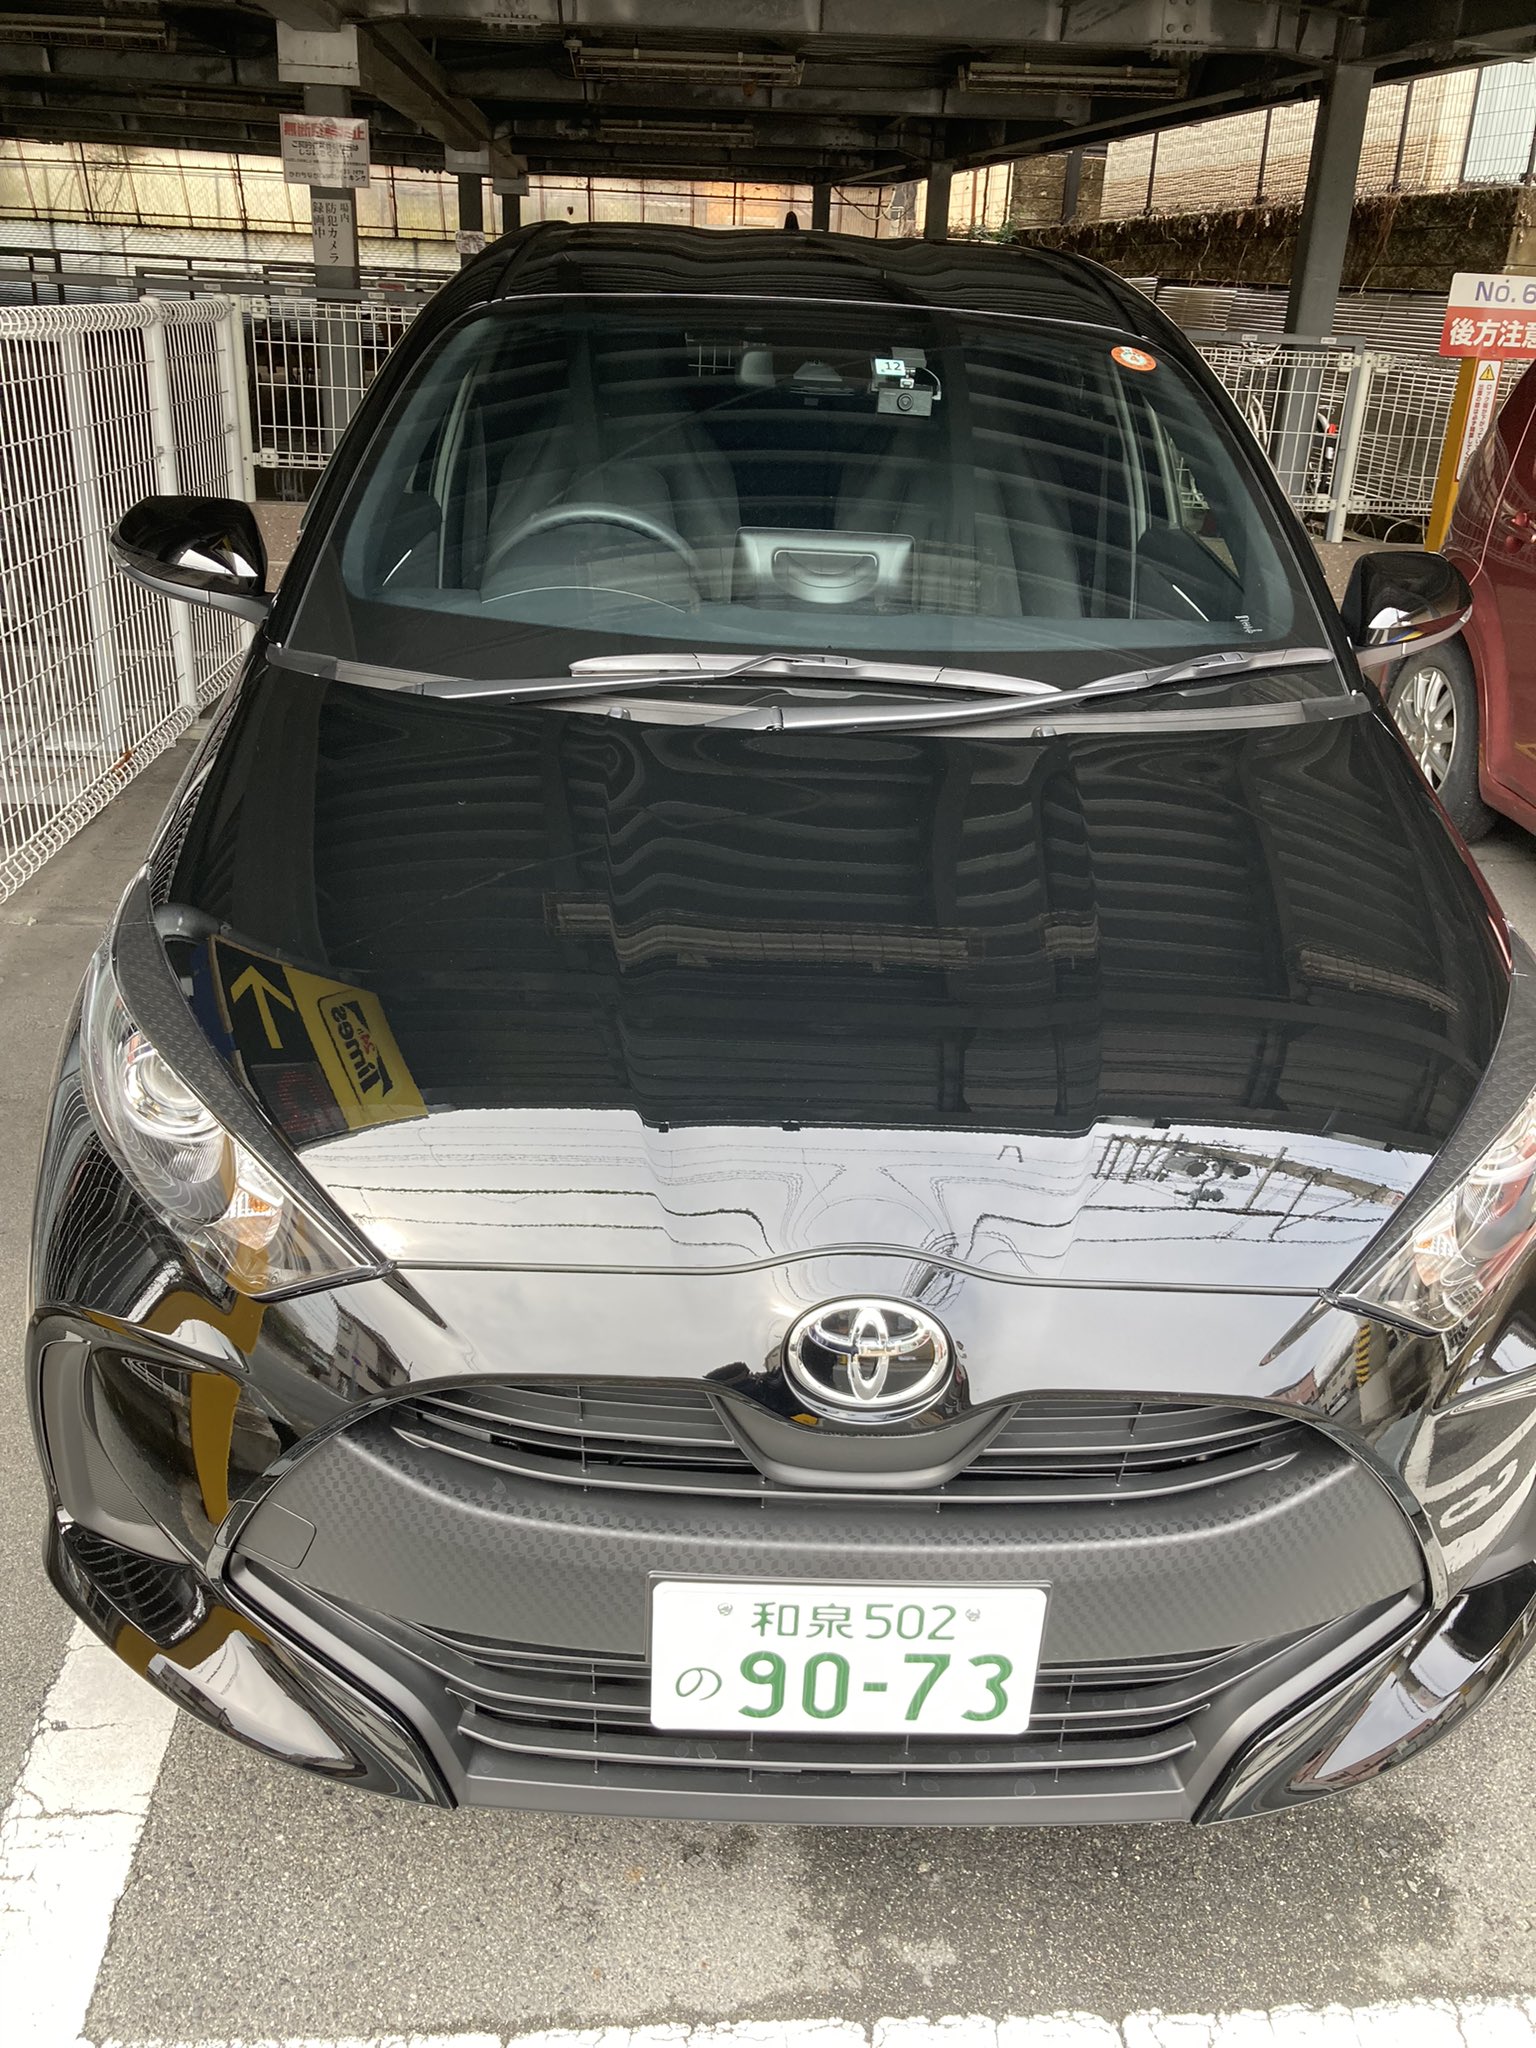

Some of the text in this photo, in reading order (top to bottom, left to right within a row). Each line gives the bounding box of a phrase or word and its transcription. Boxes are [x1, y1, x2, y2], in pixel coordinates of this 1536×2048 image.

[325, 202, 339, 264] 防犯カメラ
[885, 362, 902, 371] 12
[738, 1650, 1014, 1722] 90-73
